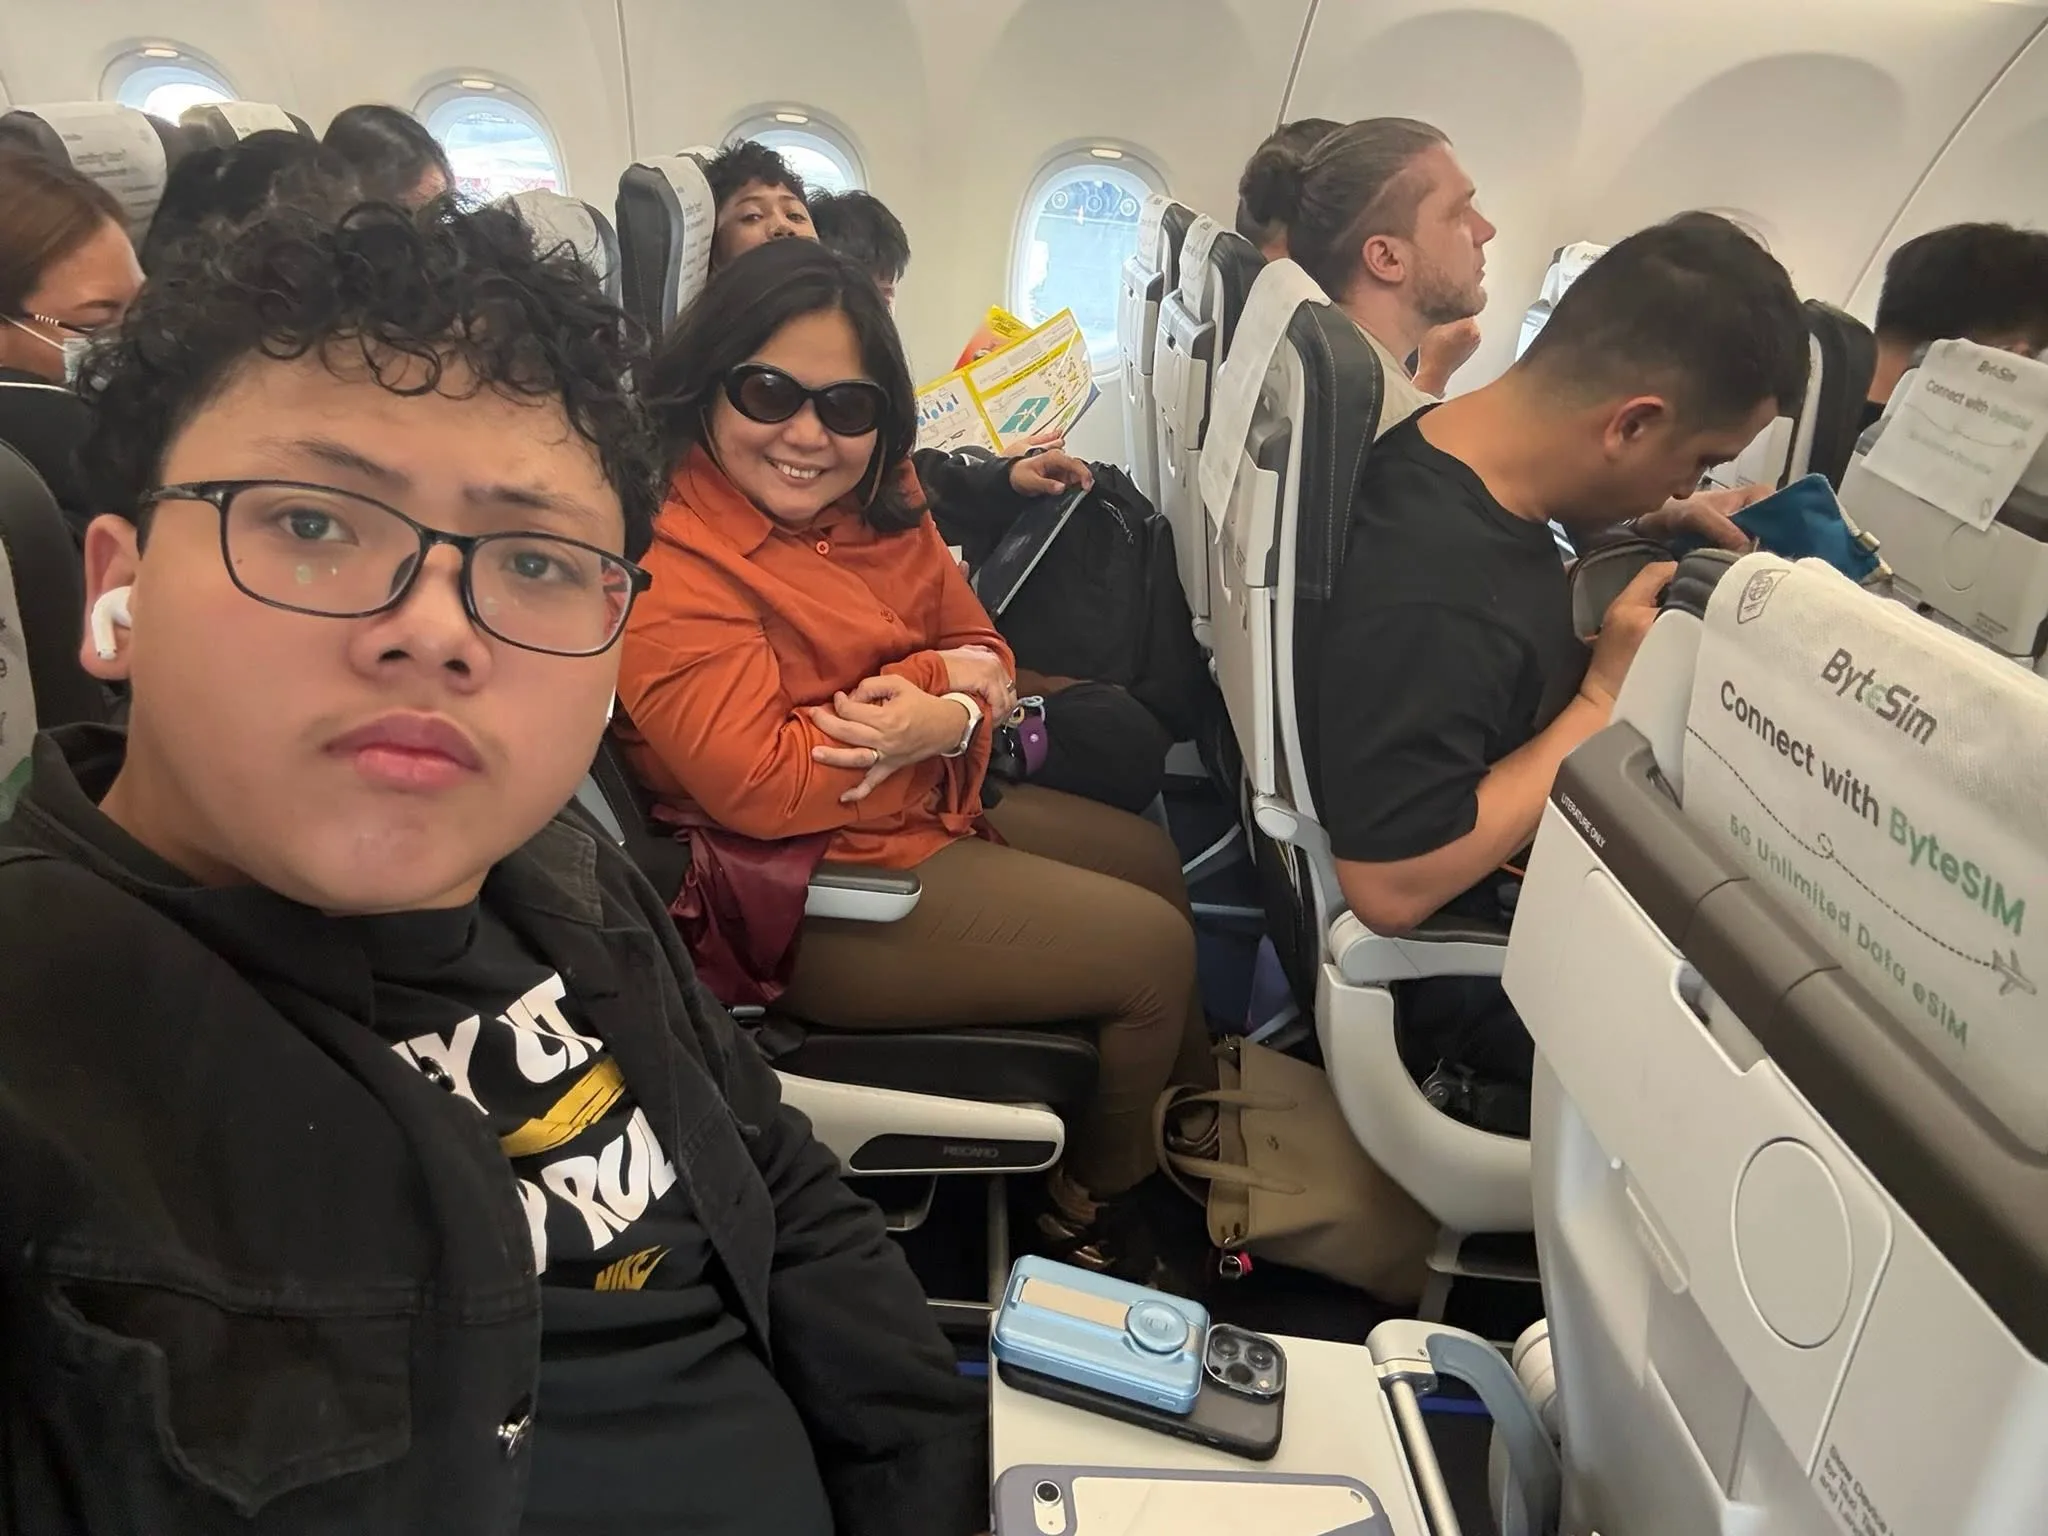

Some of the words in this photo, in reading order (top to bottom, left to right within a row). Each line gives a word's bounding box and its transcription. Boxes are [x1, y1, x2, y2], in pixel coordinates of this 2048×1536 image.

[1925, 379, 1965, 406] Connect
[1820, 647, 1938, 745] ByteSim
[1590, 827, 1606, 849] ONLY
[1720, 679, 1815, 777] Connect
[1821, 760, 1880, 828] with
[1888, 806, 2026, 937] ByteSIM
[1729, 813, 1752, 847] 5G
[1756, 837, 1851, 935] Unlimited
[1856, 922, 1907, 988] Data
[1912, 981, 1969, 1049] eSIM
[391, 1013, 490, 1117] Y
